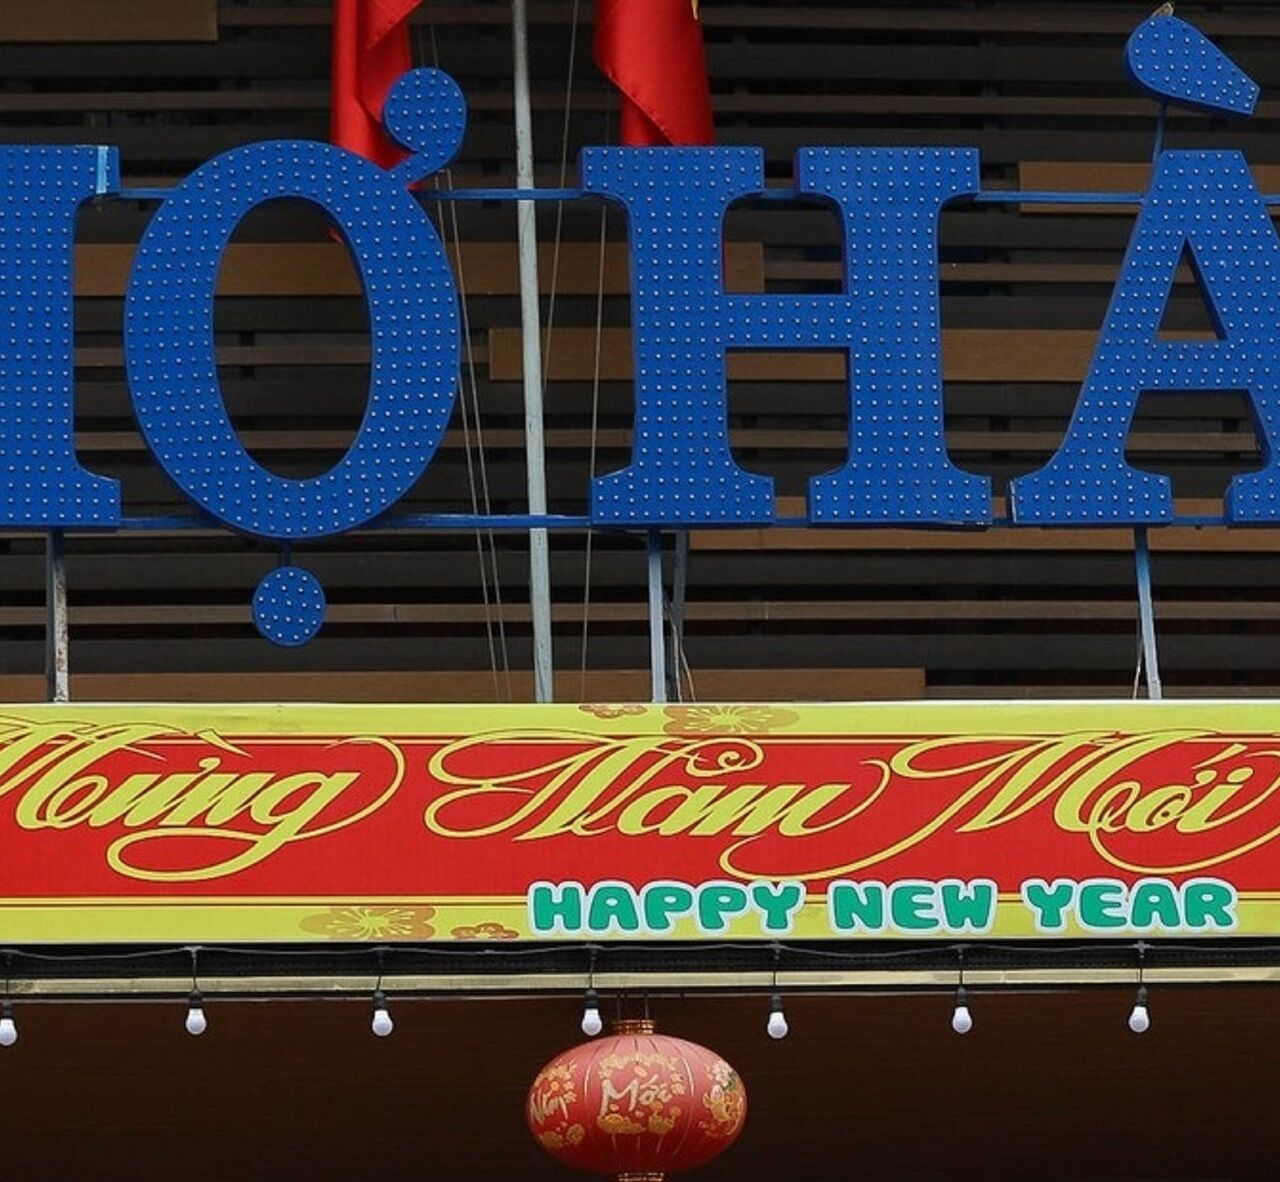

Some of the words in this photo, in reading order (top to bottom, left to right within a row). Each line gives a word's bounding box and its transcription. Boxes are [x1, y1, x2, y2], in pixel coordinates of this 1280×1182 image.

[528, 880, 805, 936] HAPPY
[827, 879, 999, 934] NEW
[1021, 878, 1239, 932] YEAR
